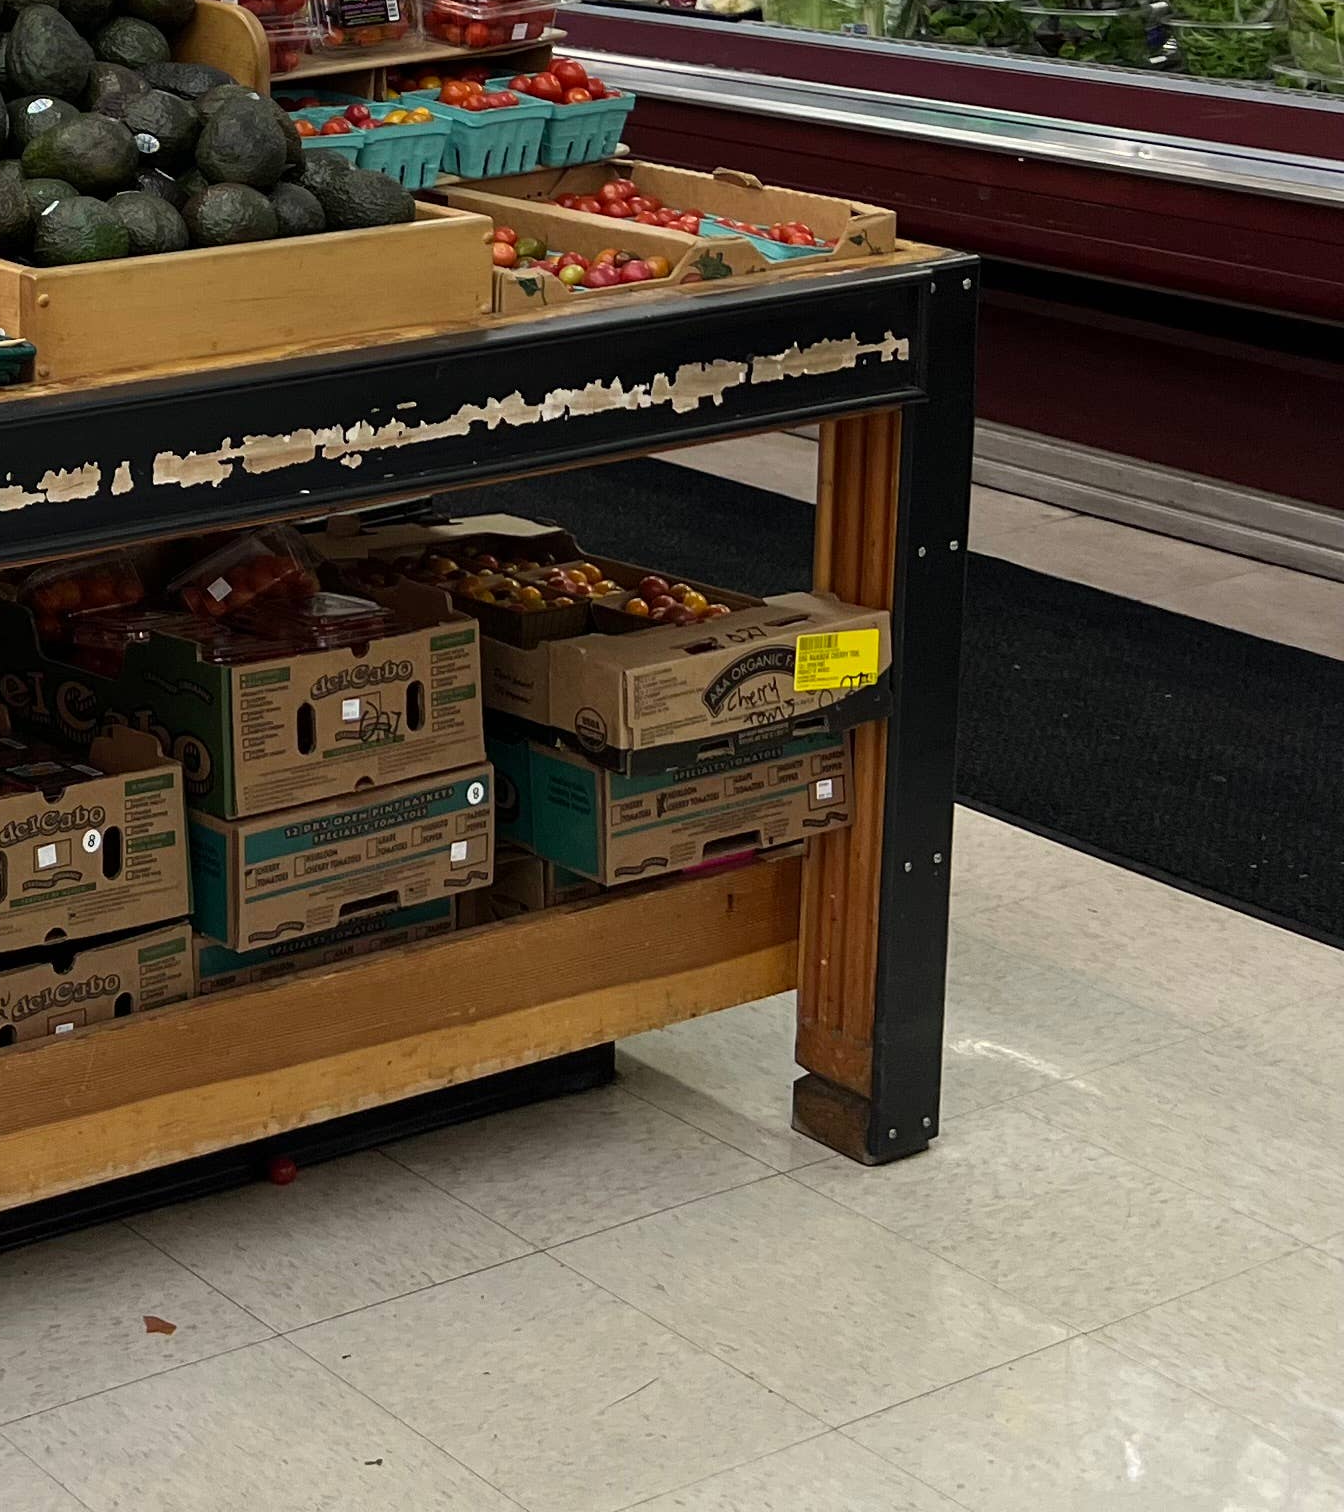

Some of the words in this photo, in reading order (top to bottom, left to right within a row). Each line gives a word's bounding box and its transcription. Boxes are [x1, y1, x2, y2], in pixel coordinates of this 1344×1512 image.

[730, 653, 785, 682] ORGANIC
[727, 676, 782, 712] Cherry
[313, 823, 371, 845] SPECIALTY
[372, 806, 430, 830] TOMATOES
[333, 812, 369, 828] OPEN
[403, 787, 455, 812] BASKETS
[87, 833, 97, 850] 8
